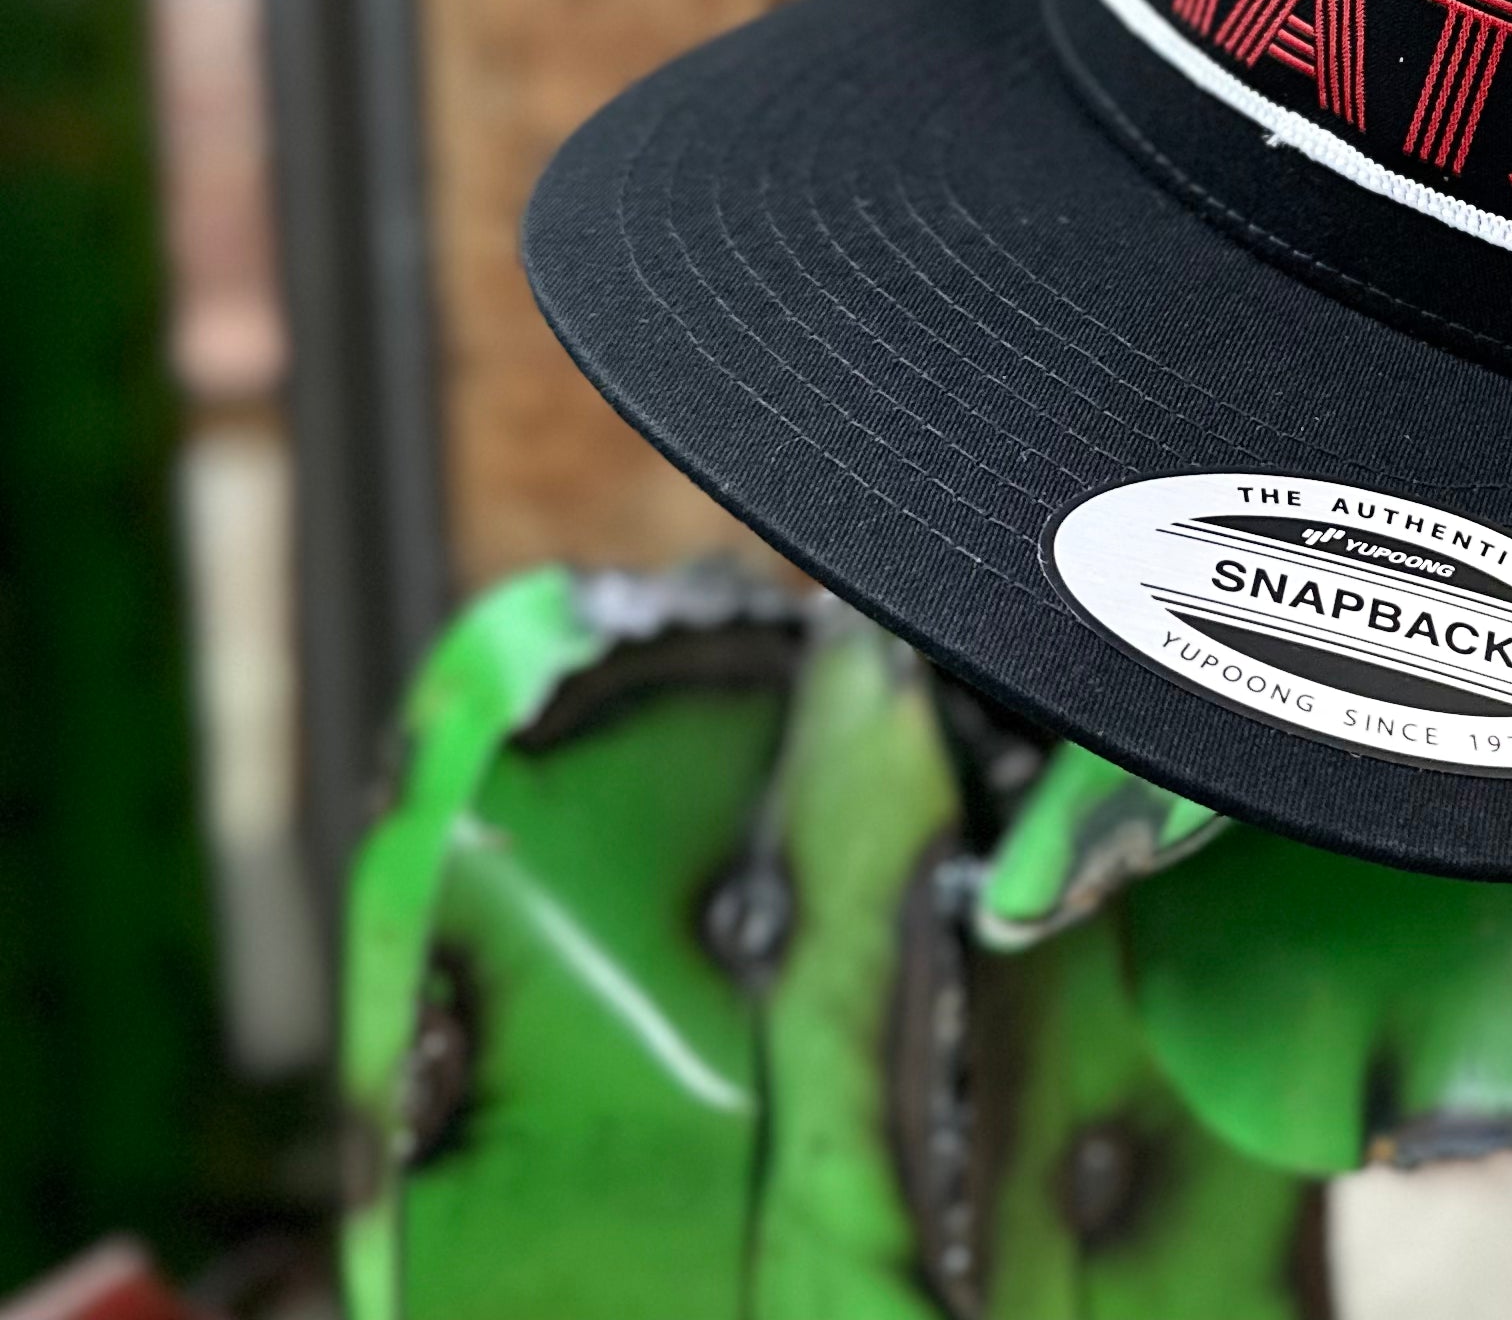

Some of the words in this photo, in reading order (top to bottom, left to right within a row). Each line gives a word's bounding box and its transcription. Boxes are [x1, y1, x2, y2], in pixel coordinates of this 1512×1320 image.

[1237, 486, 1303, 507] THE
[1343, 537, 1455, 578] YUPOONG
[1160, 630, 1314, 713] YUPOONG
[1342, 708, 1439, 746] SINCE
